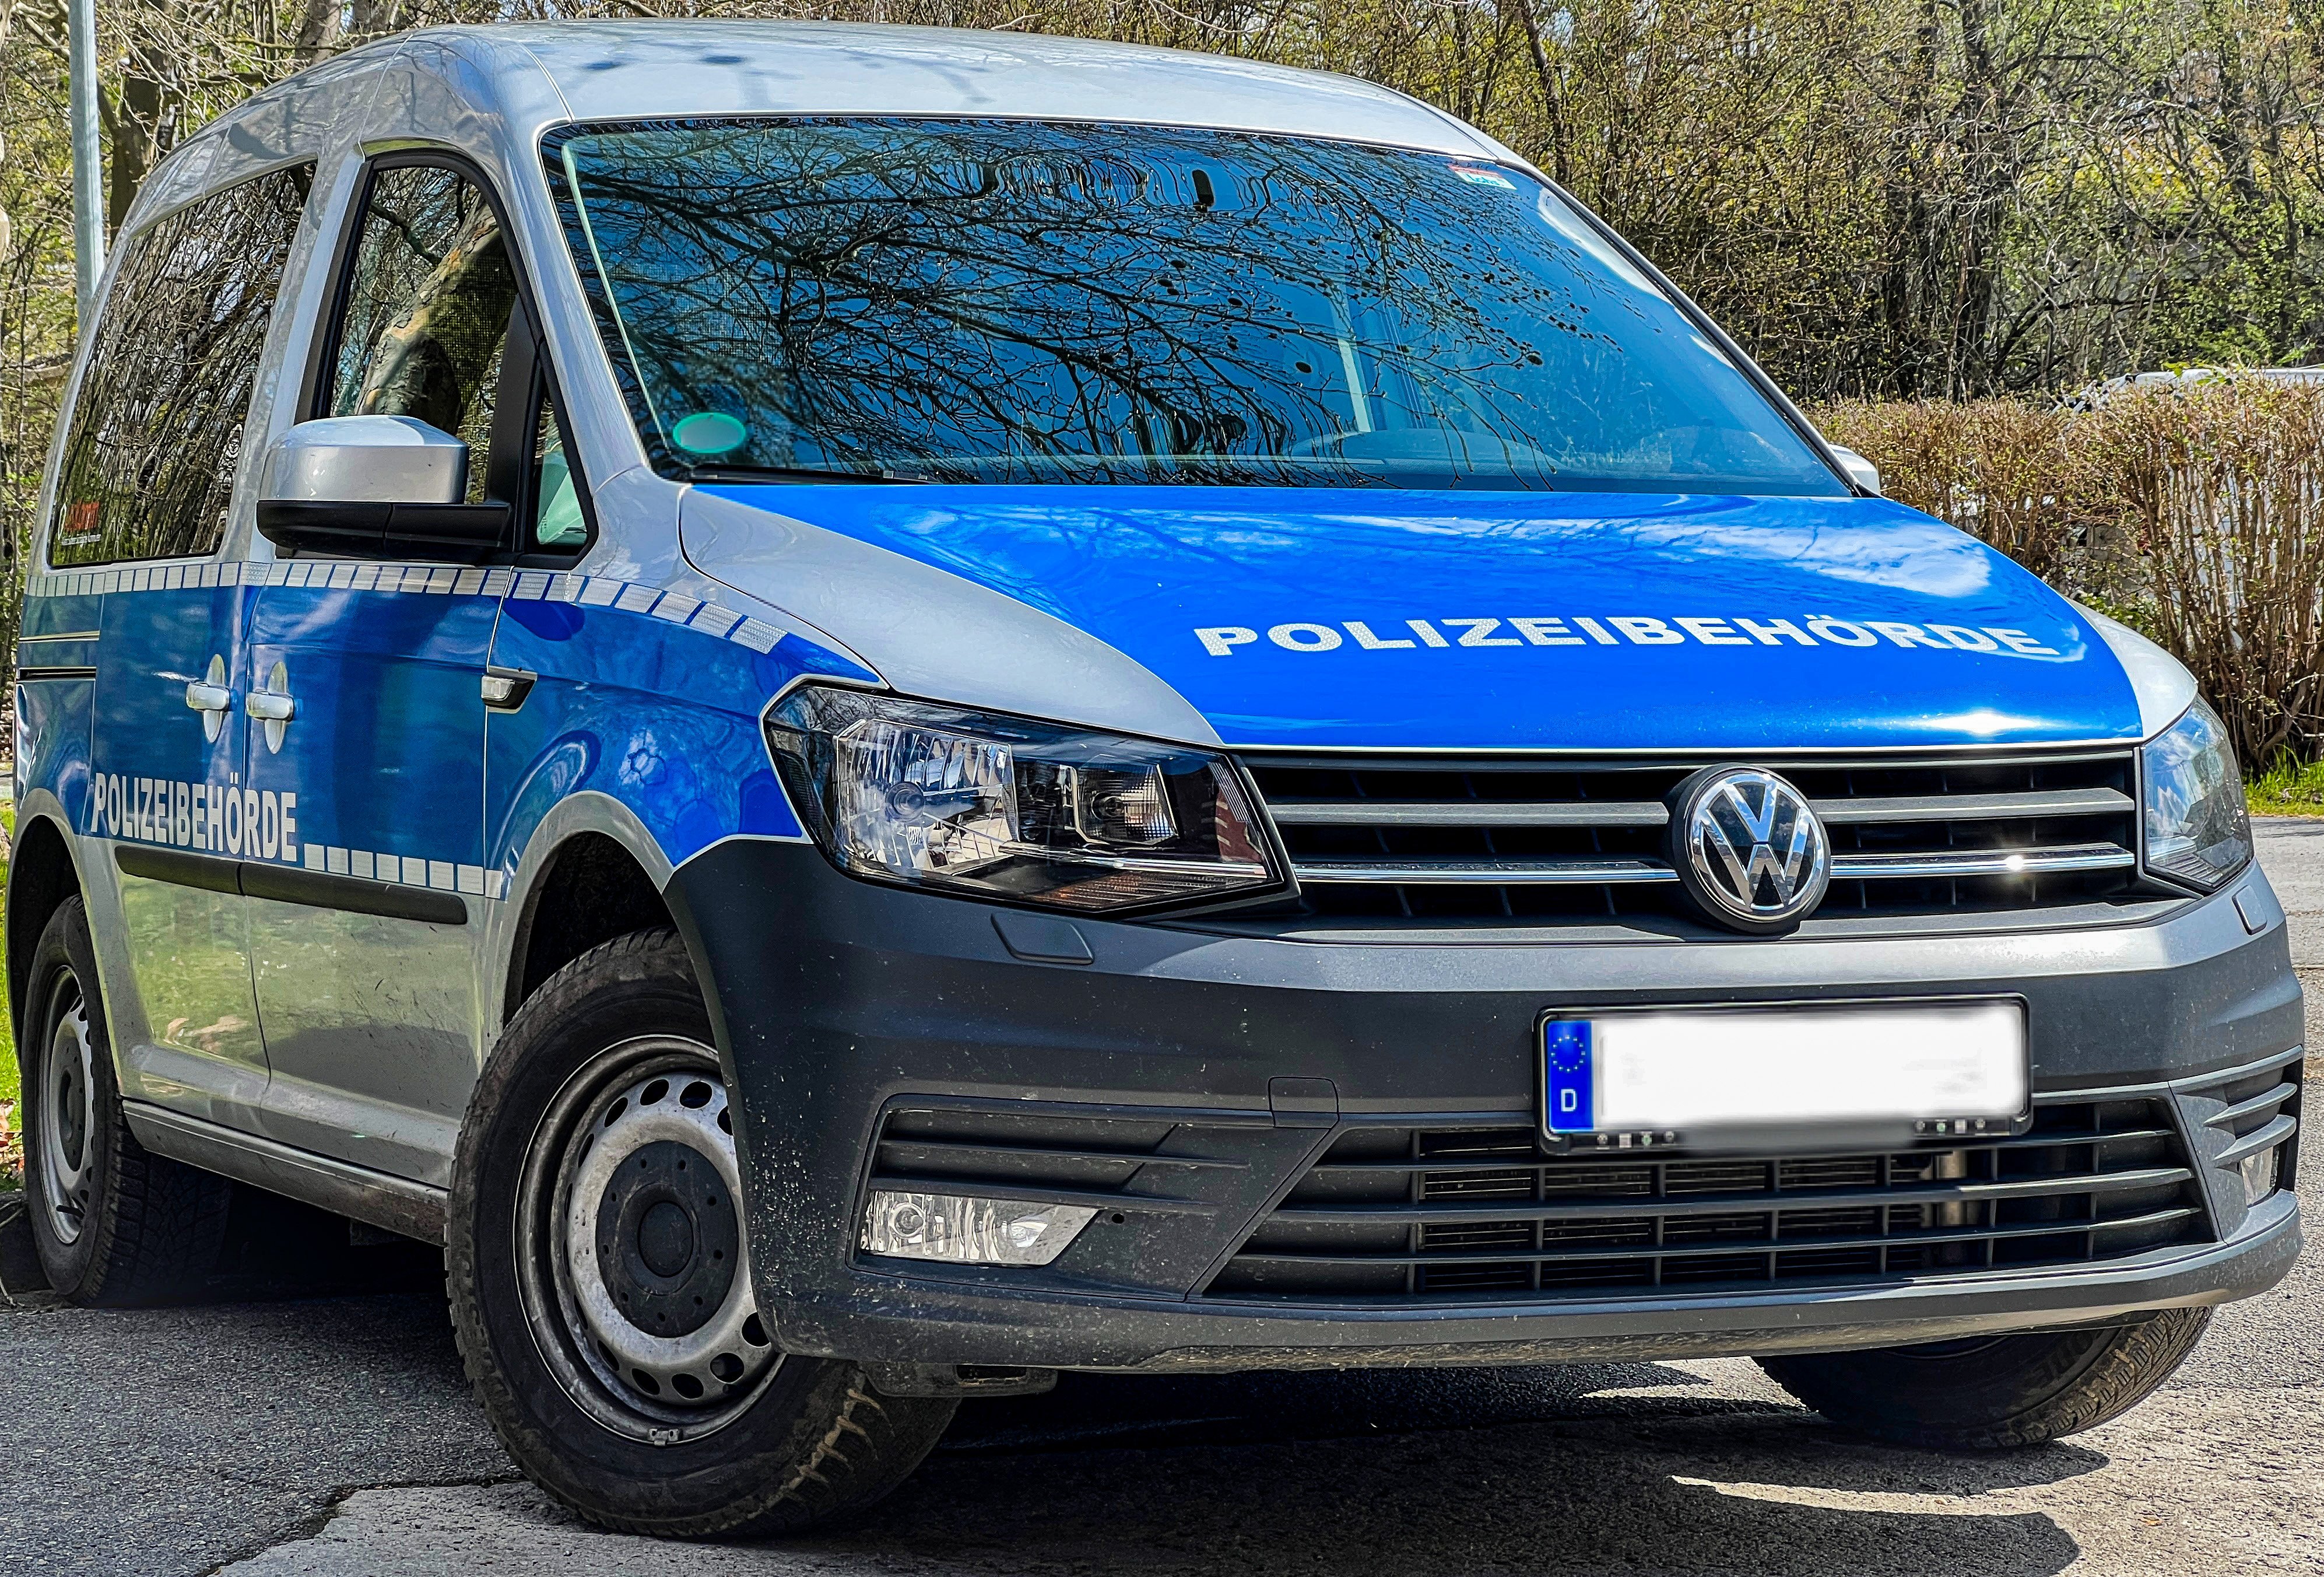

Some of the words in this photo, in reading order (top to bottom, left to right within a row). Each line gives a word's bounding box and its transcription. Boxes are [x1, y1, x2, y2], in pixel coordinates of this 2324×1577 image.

[1193, 614, 2060, 656] POLIZEIBEHÖRDE
[90, 772, 297, 862] POLIZEIBEHÖRDE
[1690, 773, 1824, 919] VW
[1561, 1089, 1577, 1112] D
